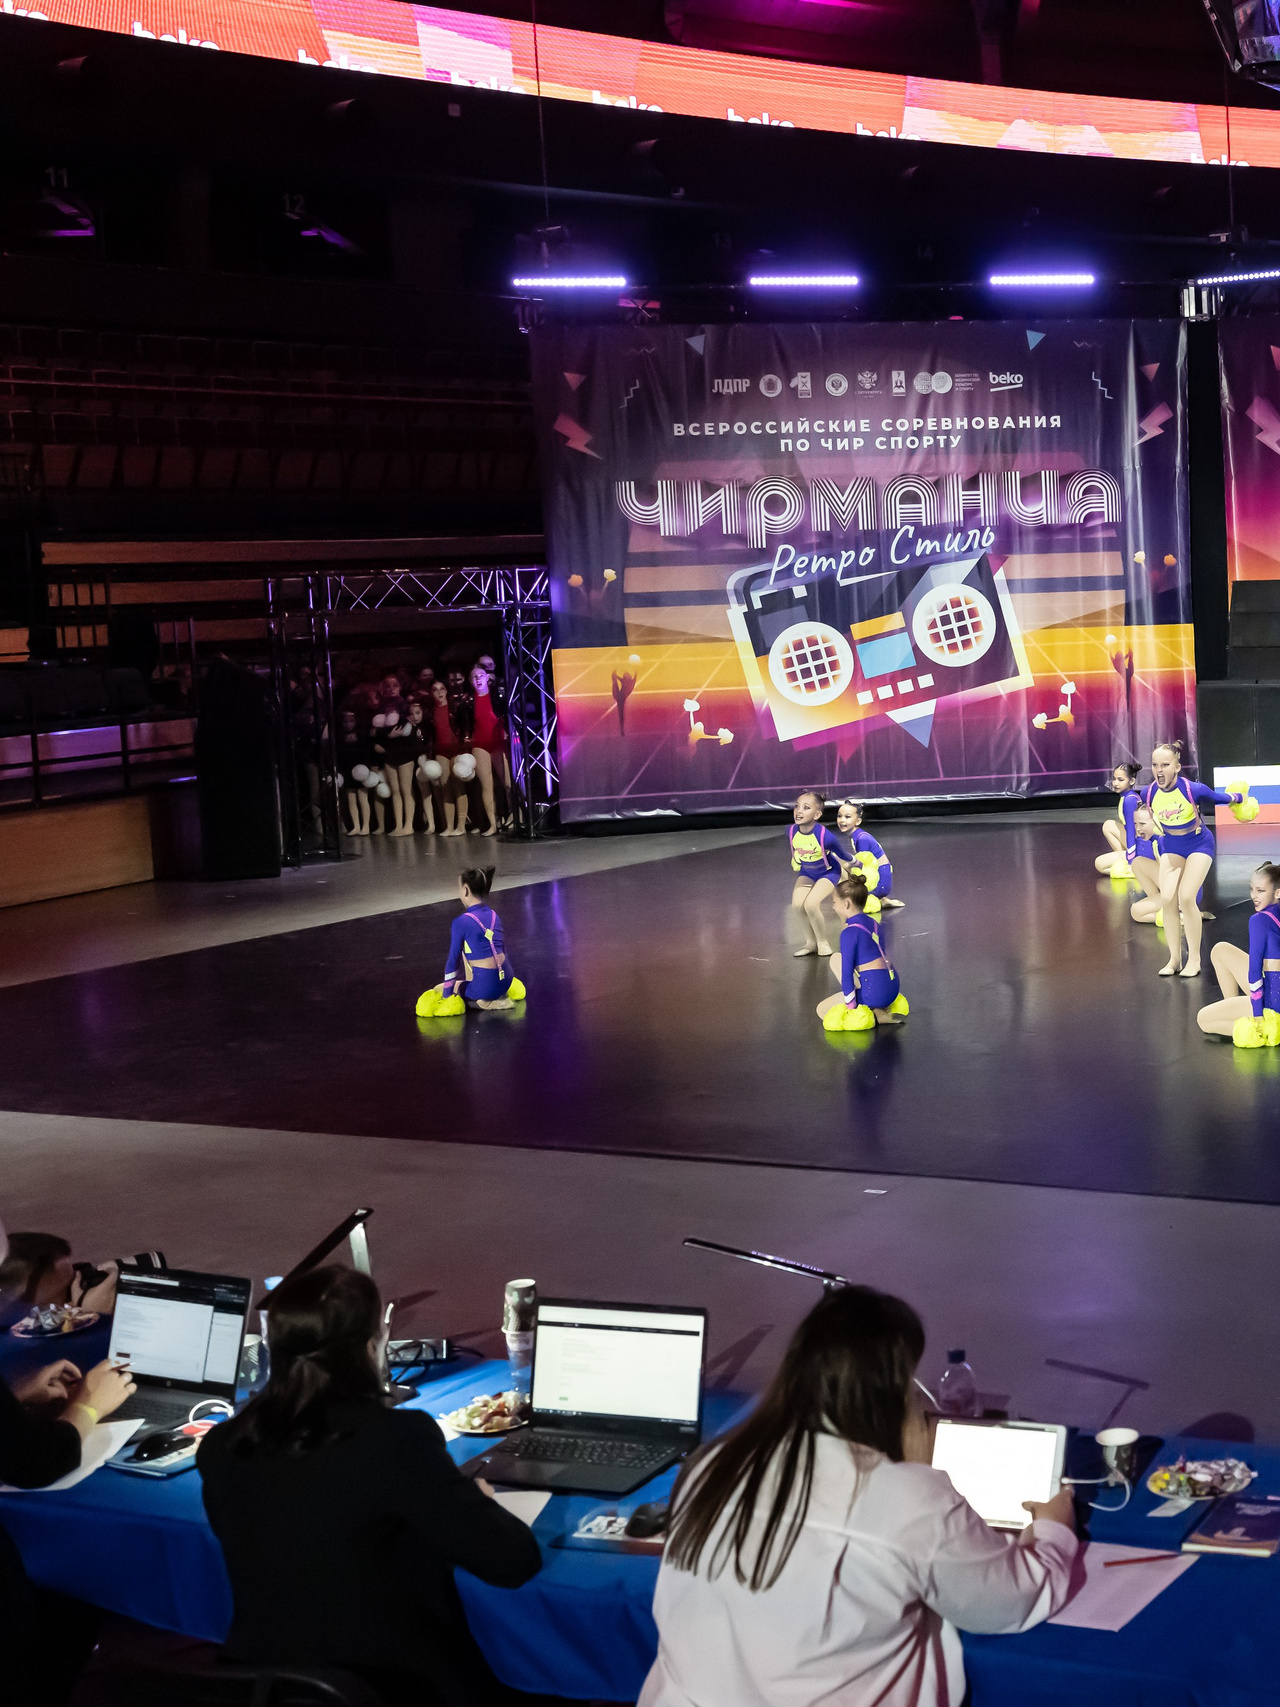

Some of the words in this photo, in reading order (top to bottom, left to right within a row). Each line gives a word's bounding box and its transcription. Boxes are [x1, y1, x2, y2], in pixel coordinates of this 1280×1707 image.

[43, 166, 68, 188] 11
[712, 378, 751, 395] ЛДПР
[989, 371, 1024, 385] beko
[673, 417, 871, 436] ВСЕРОССИЙСКИЕ
[881, 415, 1061, 432] СОРЕВНОВАНИЯ
[780, 438, 810, 452] ПО
[820, 437, 865, 451] ЧИР
[875, 435, 962, 450] СПОРТУ
[769, 543, 876, 586] Ретро
[890, 524, 996, 565] Стиль
